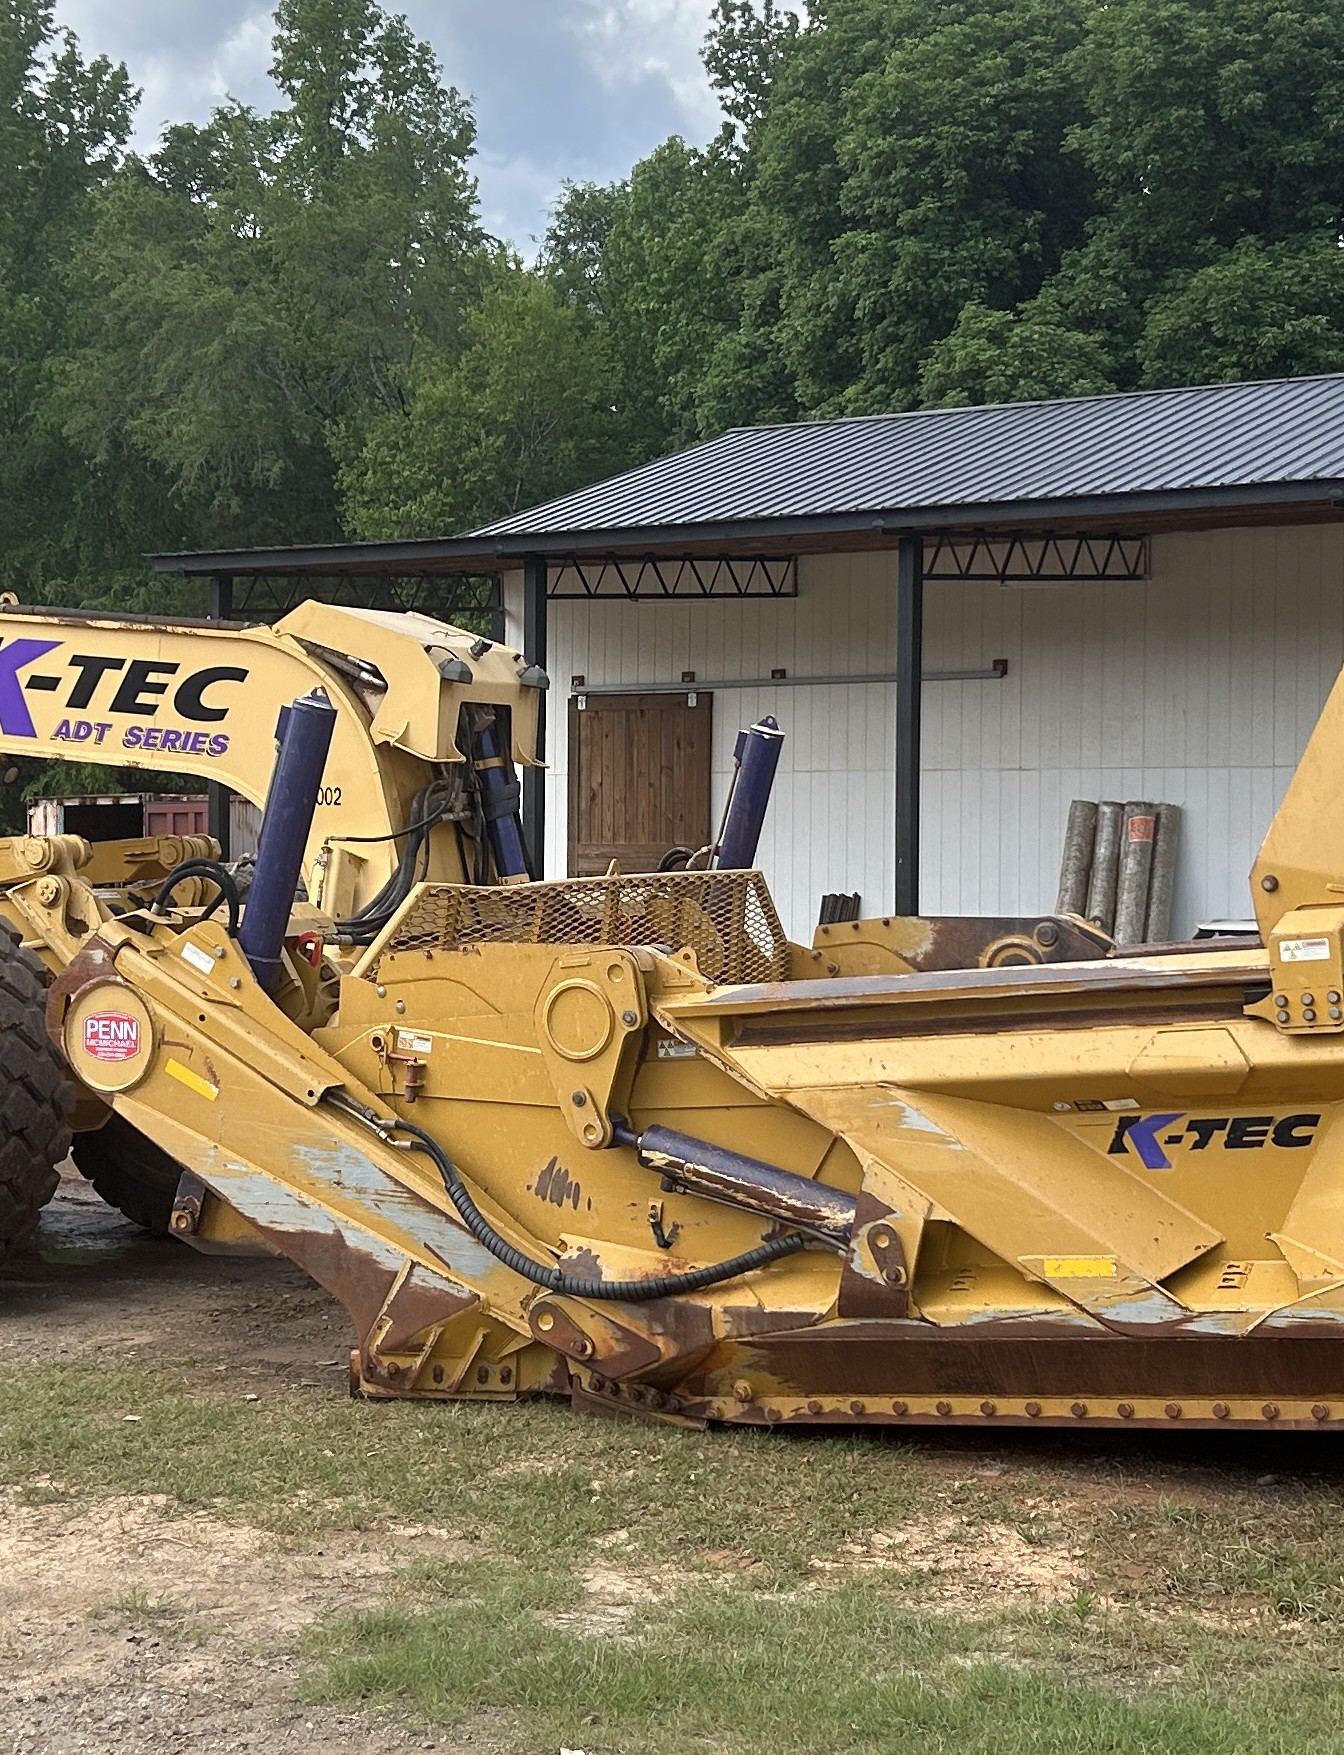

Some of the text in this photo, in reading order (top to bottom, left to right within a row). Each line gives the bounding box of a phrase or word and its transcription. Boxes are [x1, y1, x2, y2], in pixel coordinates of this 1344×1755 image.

[50, 719, 231, 756] ADT SERIES
[86, 1019, 137, 1041] PENN
[1107, 1112, 1322, 1169] K-TEC
